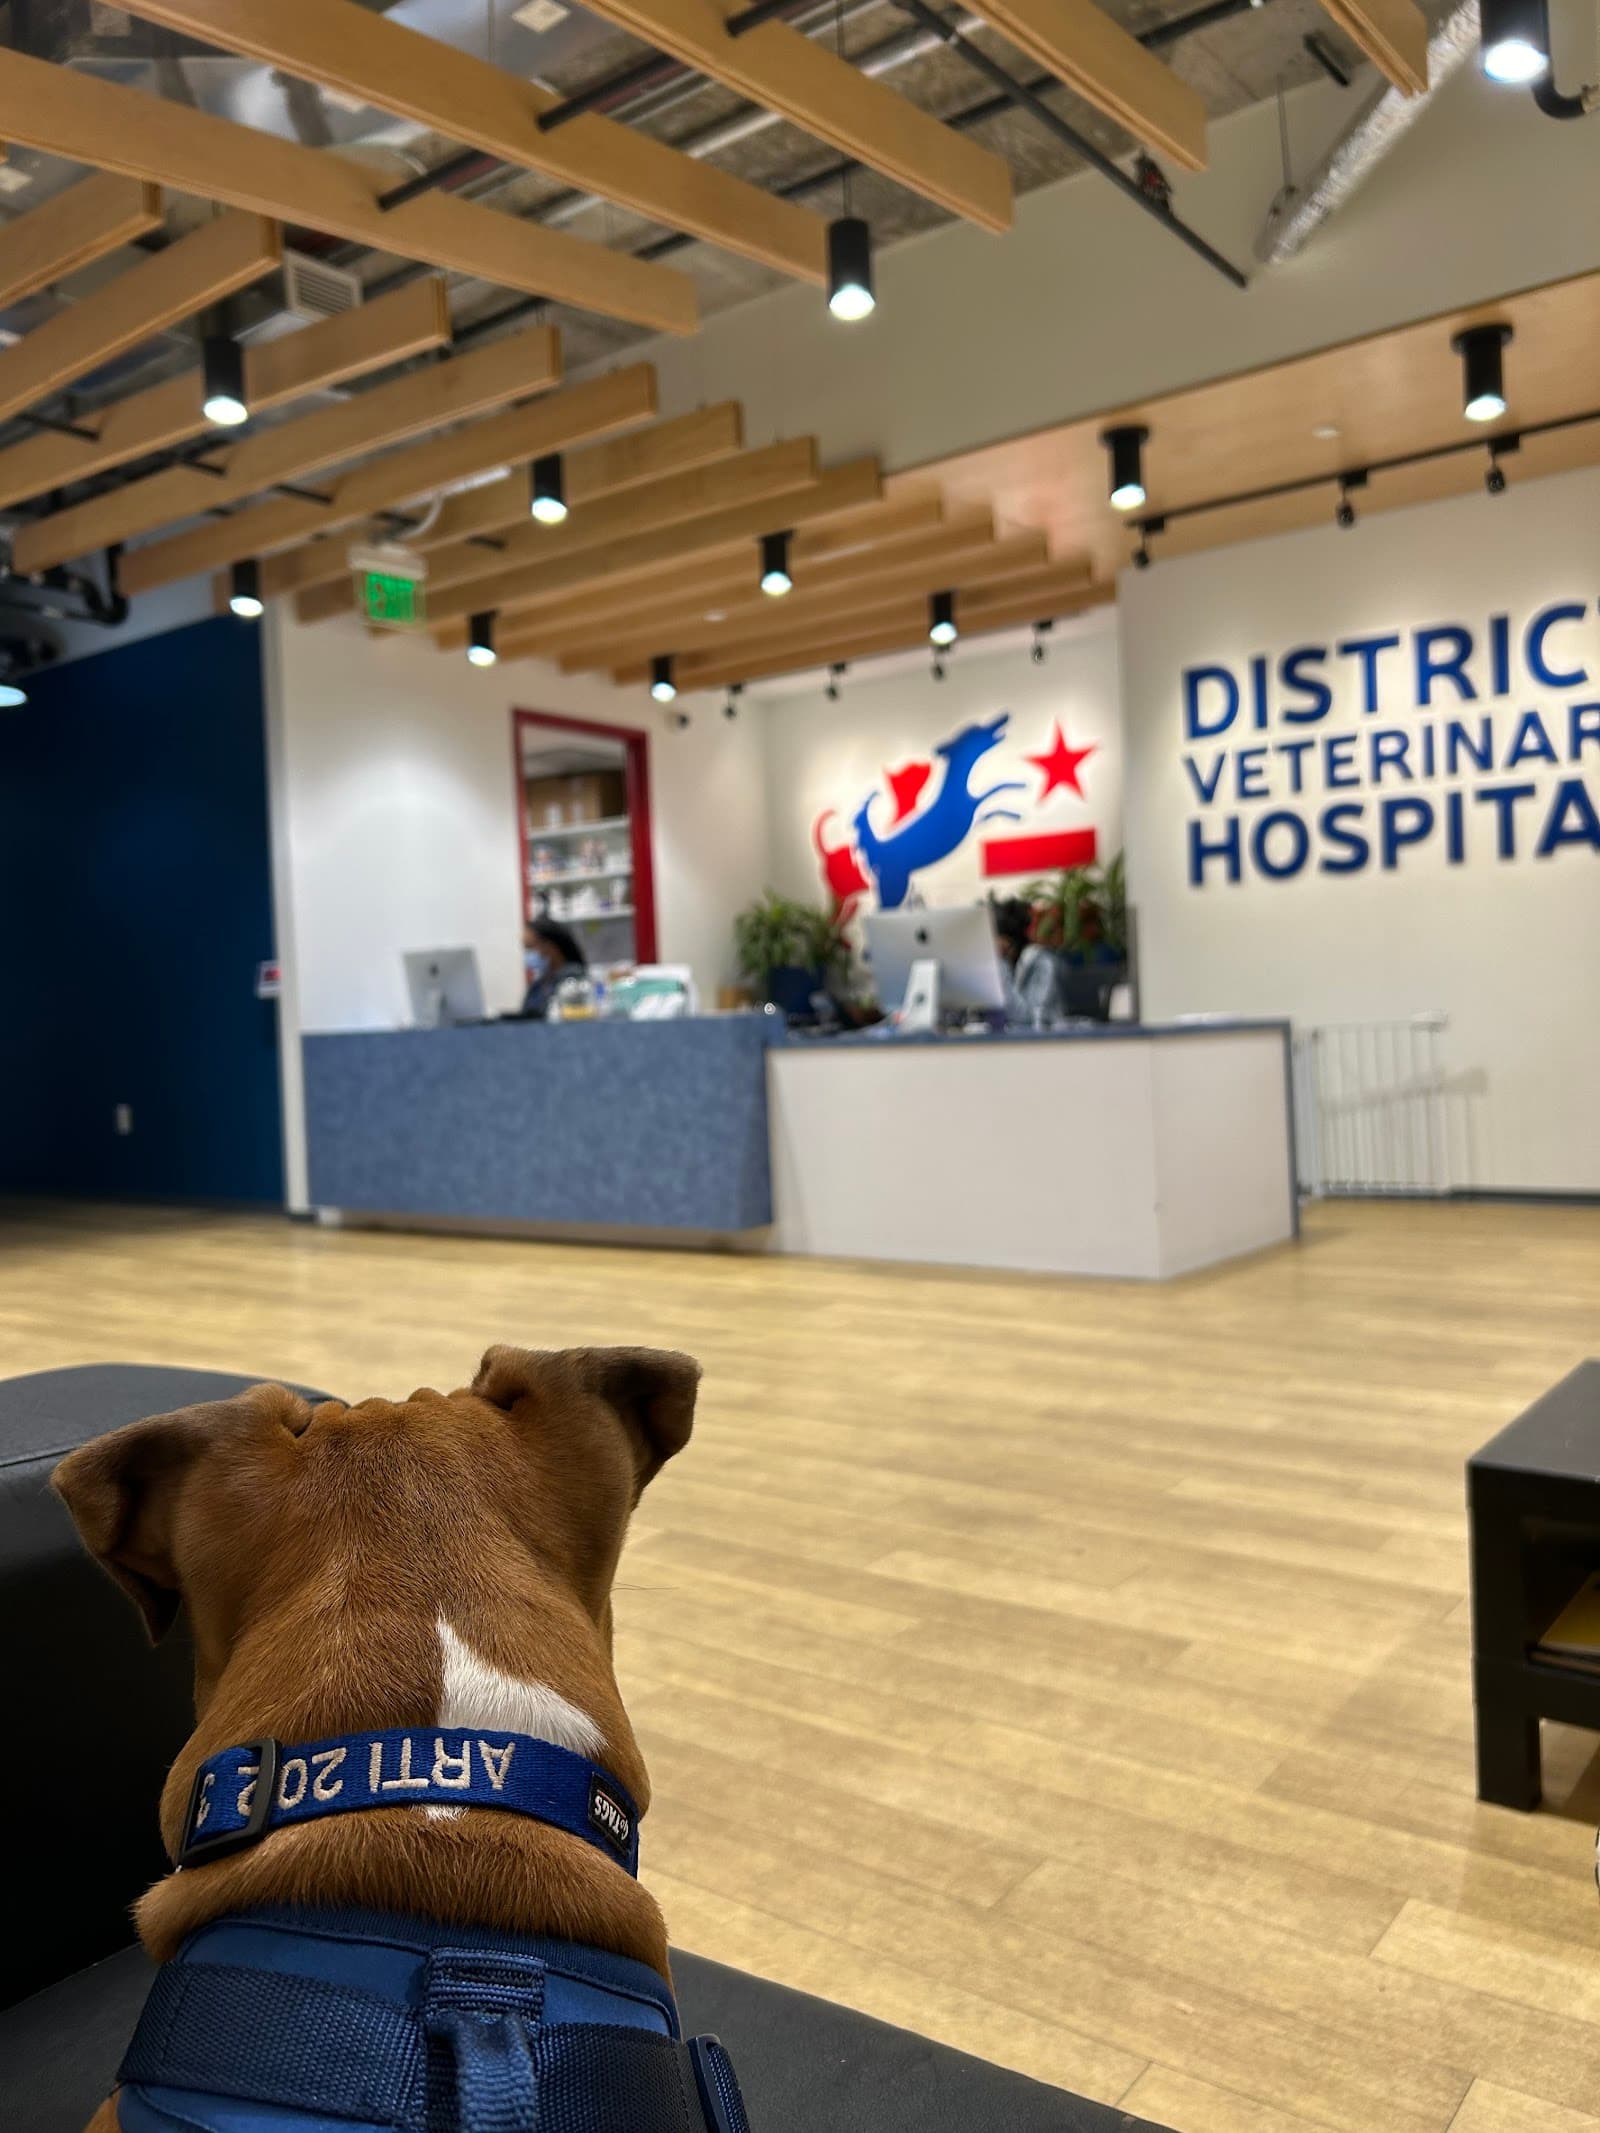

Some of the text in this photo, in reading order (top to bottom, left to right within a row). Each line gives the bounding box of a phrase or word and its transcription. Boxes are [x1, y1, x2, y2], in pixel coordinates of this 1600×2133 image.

[1184, 594, 1600, 741] DISTRIC
[1189, 778, 1600, 886] HOSPITA
[368, 1737, 516, 1793] ARTI
